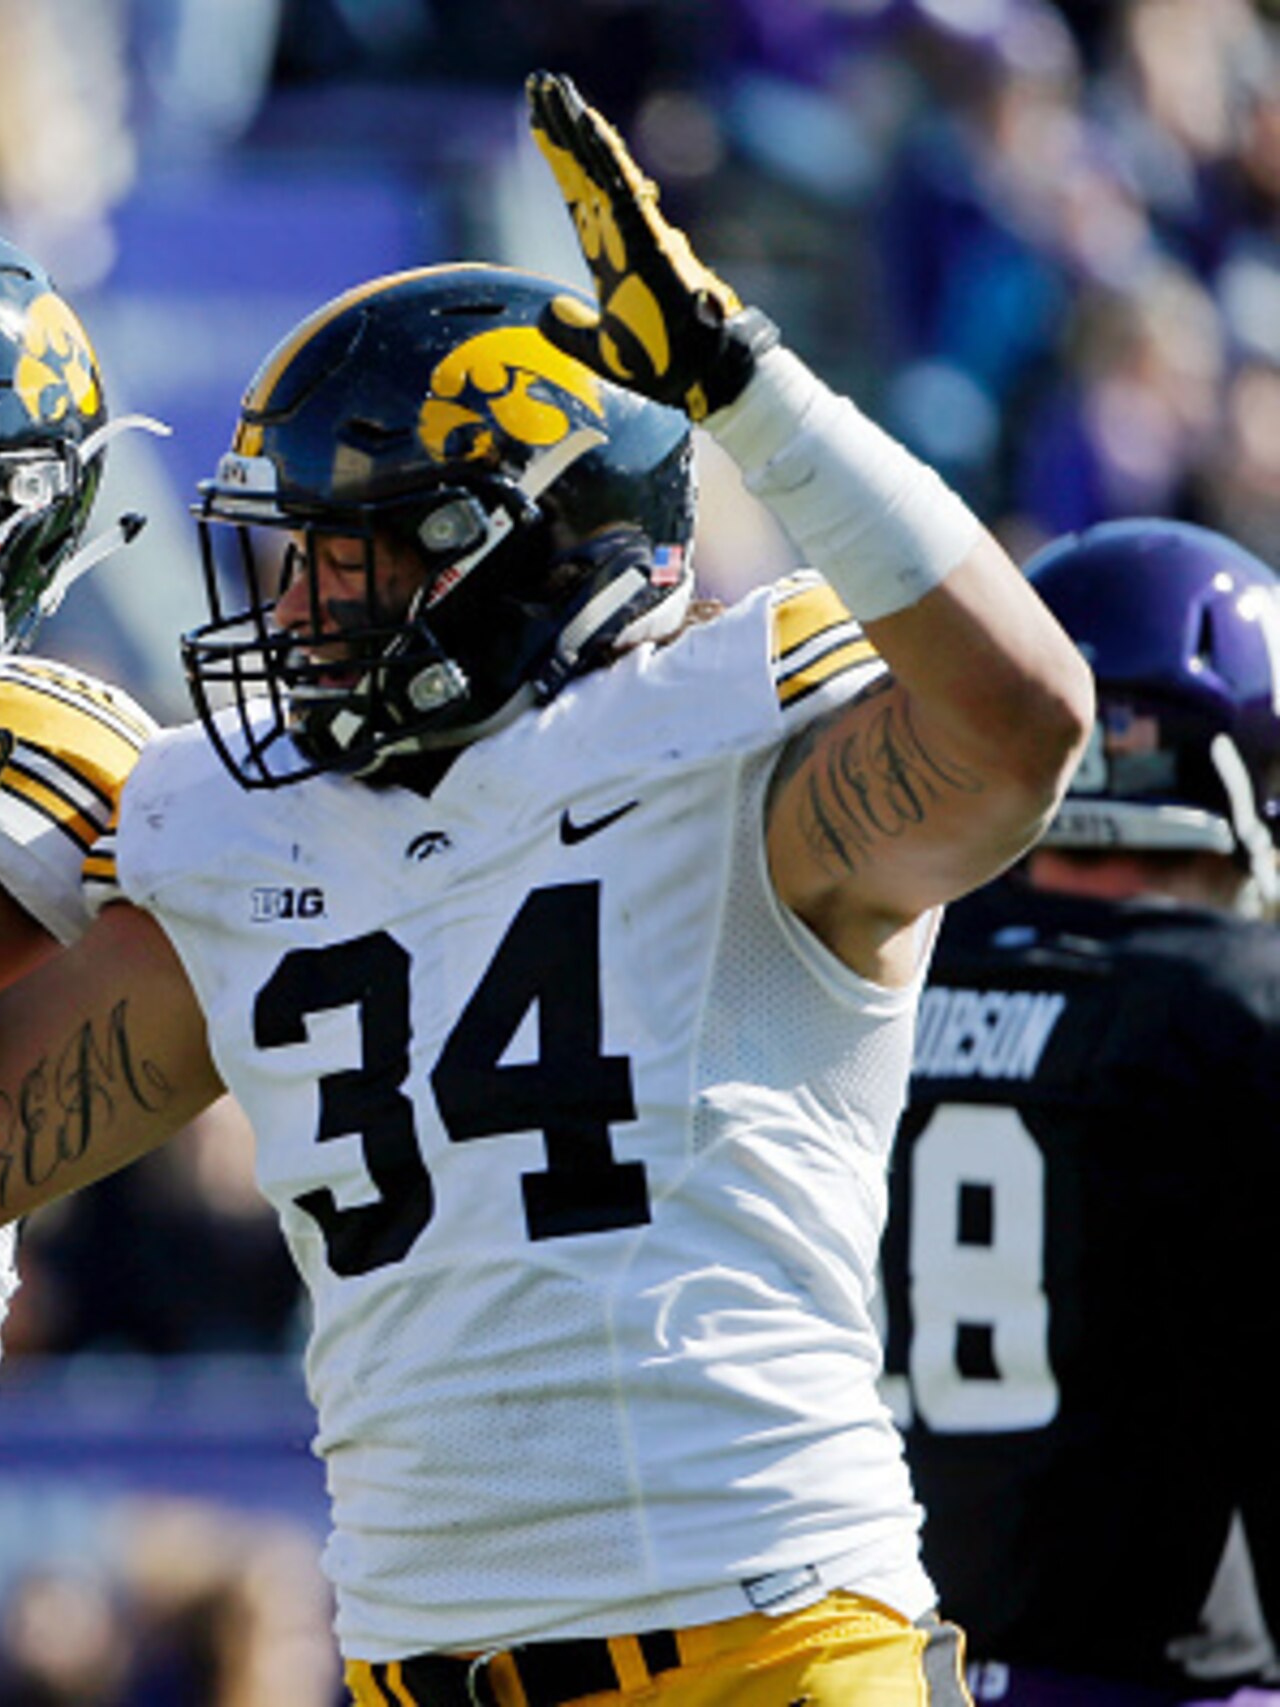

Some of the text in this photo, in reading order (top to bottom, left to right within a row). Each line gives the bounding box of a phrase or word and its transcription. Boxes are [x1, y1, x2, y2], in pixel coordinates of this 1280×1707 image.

[252, 879, 653, 1280] 34
[909, 986, 1066, 1080] ORSON
[879, 1103, 1061, 1434] 8
